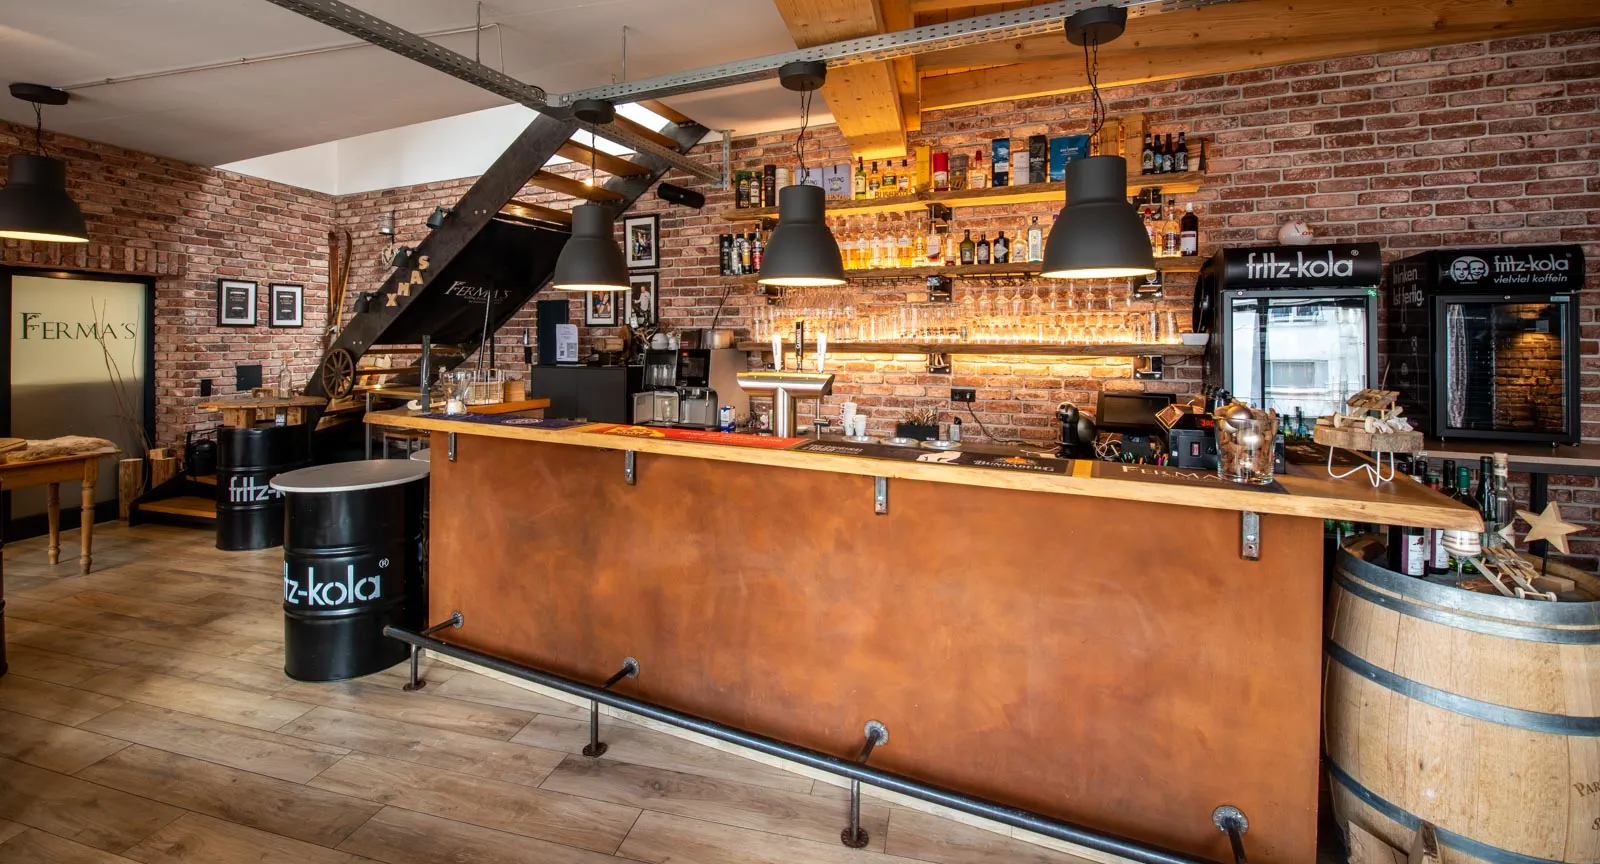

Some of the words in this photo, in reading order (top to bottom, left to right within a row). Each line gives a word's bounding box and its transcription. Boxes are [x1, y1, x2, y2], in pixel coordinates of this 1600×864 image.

[1246, 250, 1353, 279] fritz-kola
[1493, 253, 1569, 273] fritz-kola
[1493, 274, 1530, 284] vielviel
[1532, 273, 1568, 283] koffein
[284, 560, 381, 606] tz-kola
